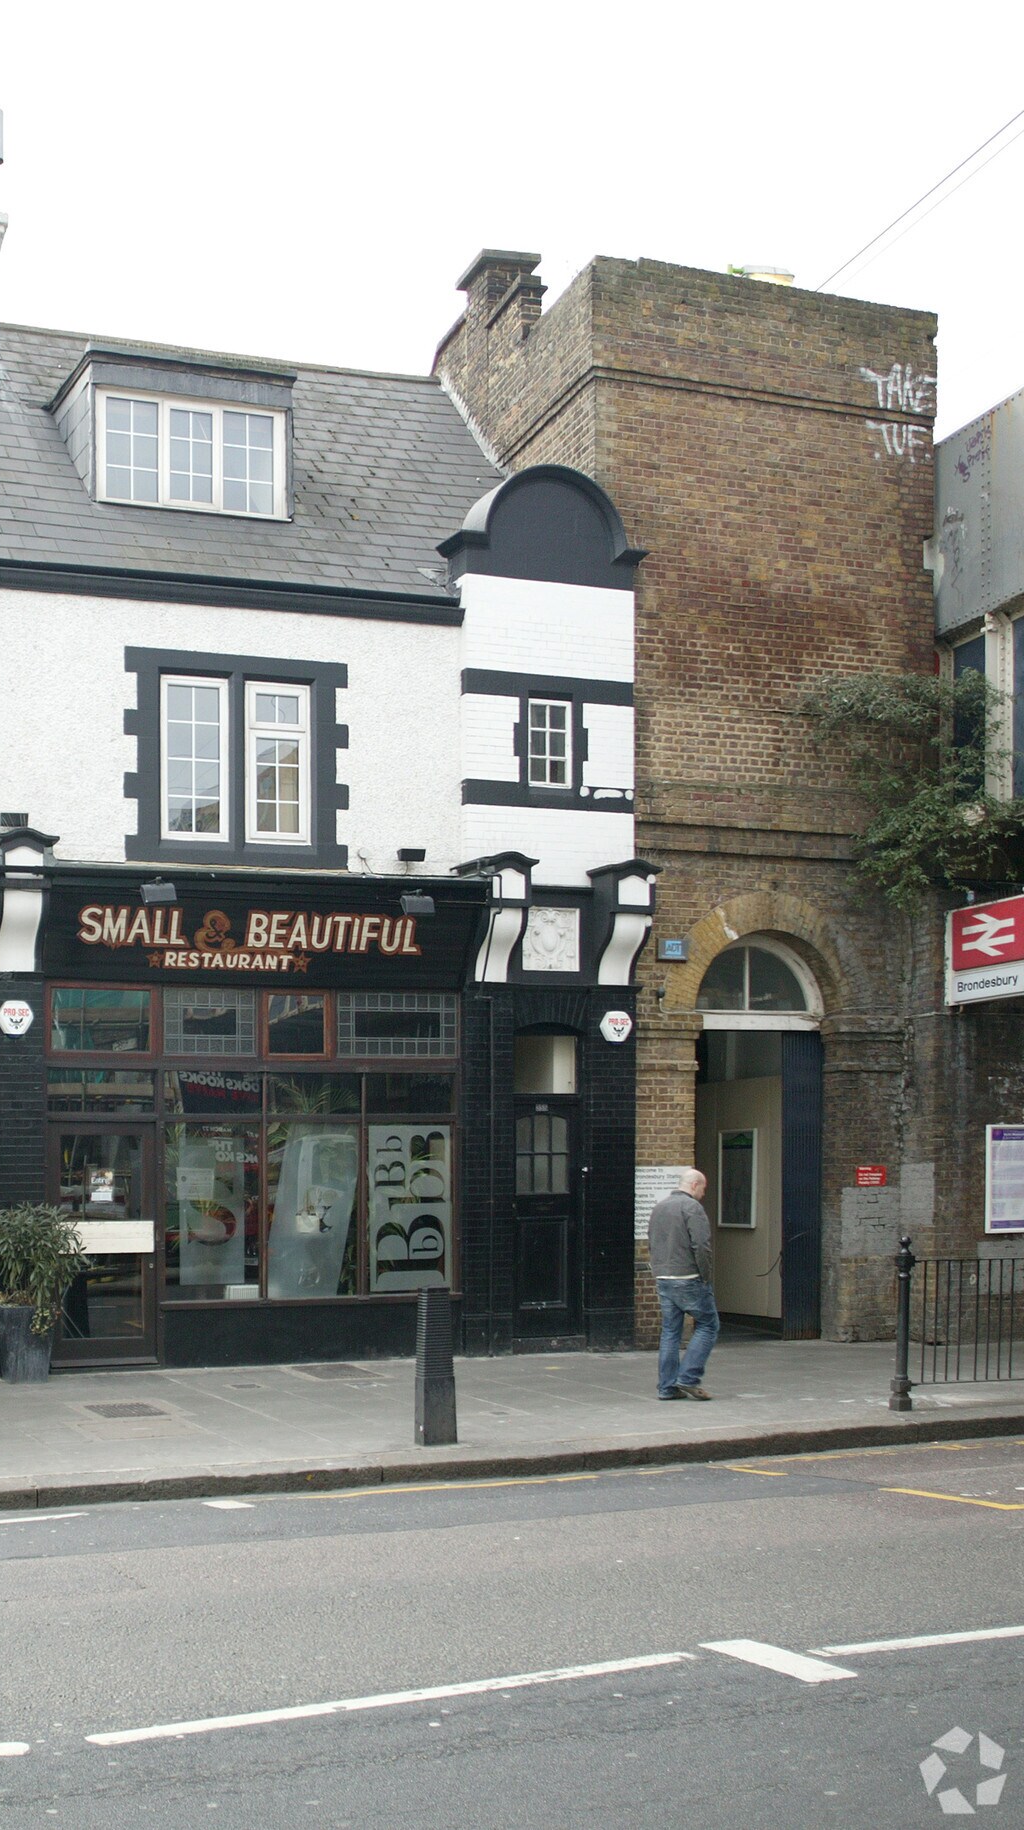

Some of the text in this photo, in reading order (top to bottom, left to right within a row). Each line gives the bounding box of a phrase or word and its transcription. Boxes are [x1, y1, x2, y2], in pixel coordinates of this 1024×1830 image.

[78, 908, 420, 954] SMALL & BEAUTIFUL
[163, 950, 294, 971] RESTAURANT
[957, 975, 1018, 992] Brondesbury
